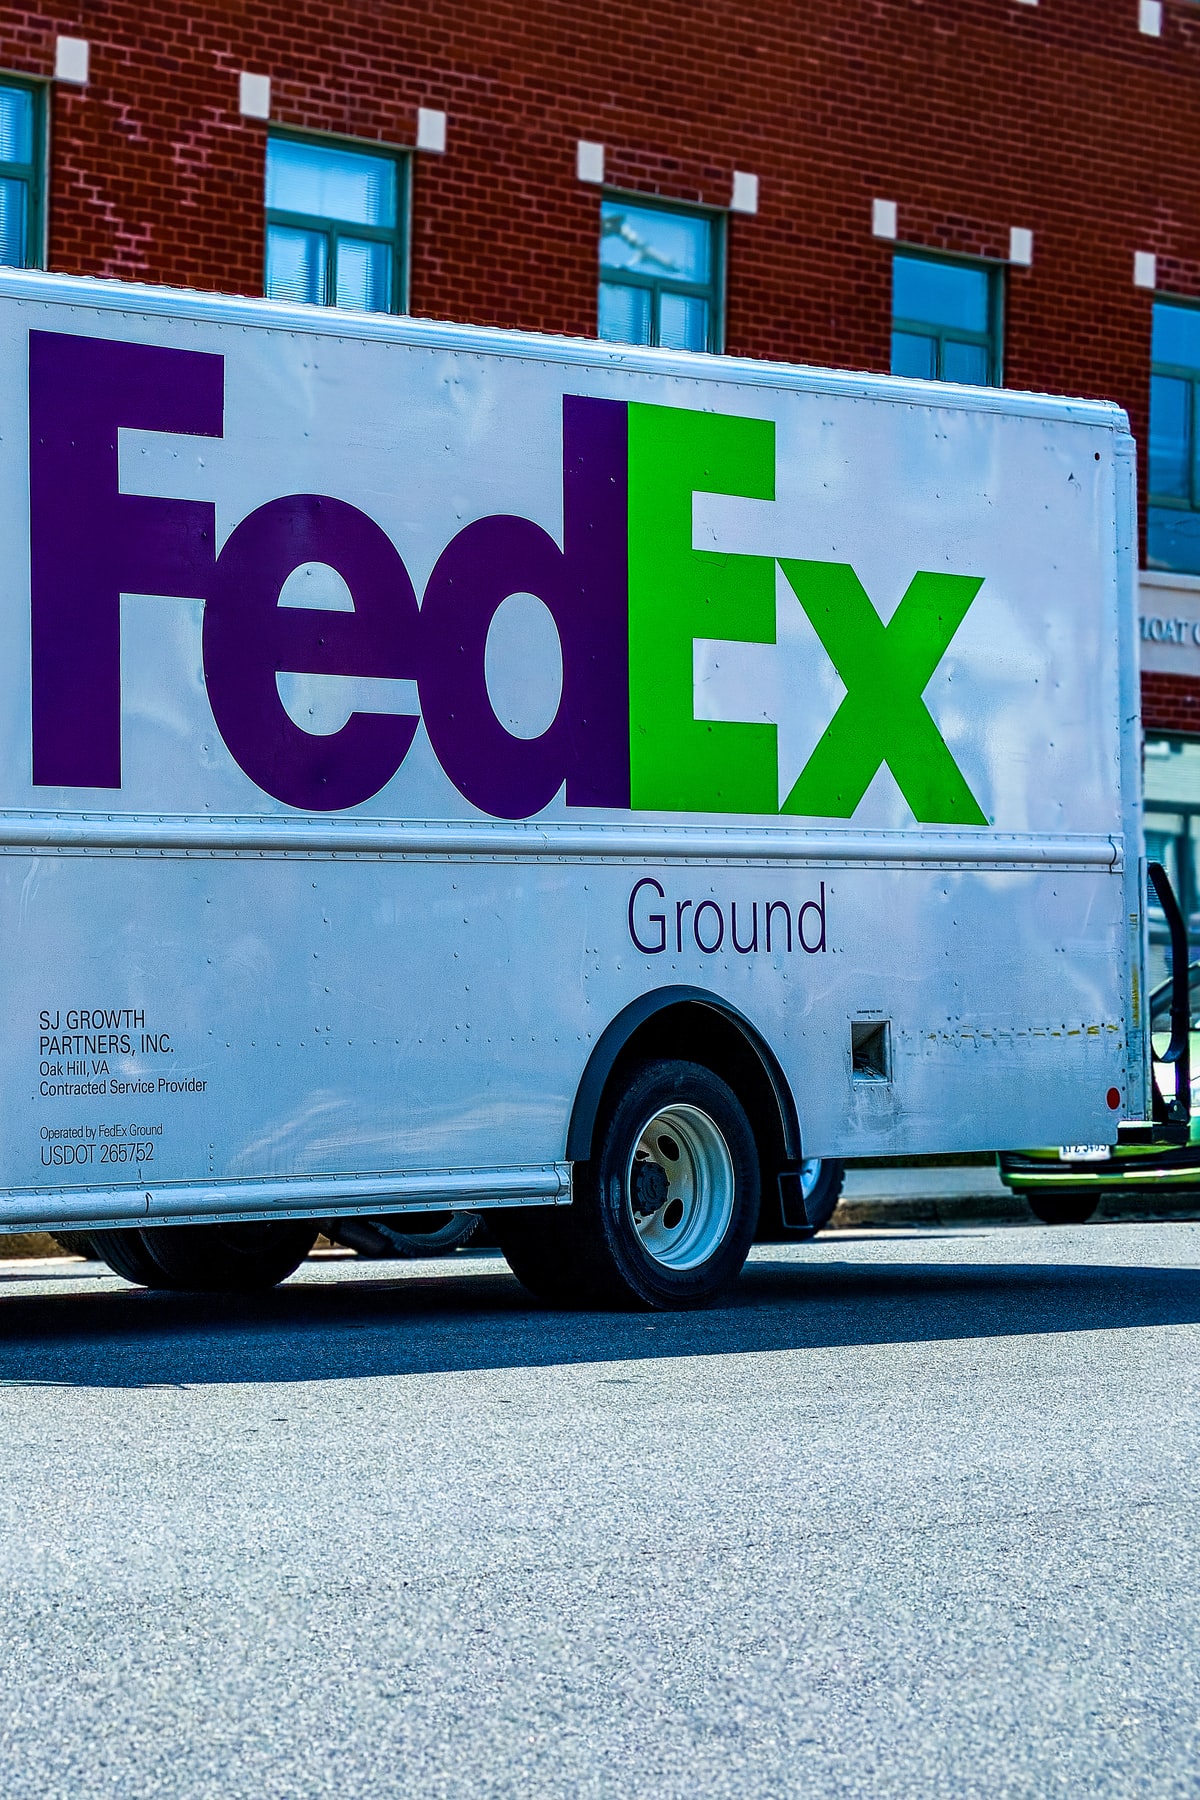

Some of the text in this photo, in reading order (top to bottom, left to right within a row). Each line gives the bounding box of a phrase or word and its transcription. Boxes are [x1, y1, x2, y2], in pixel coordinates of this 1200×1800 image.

[29, 329, 989, 827] FedEx
[628, 877, 829, 955] Ground
[39, 1009, 145, 1030] SJ GROWTH
[39, 1034, 174, 1056] PARTNERS, INC.
[39, 1060, 110, 1077] Oak Hill, VA
[39, 1078, 208, 1096] Contracted Service Provider
[40, 1123, 163, 1141] Operated by FedEx Ground
[41, 1142, 154, 1165] USDOT 265752
